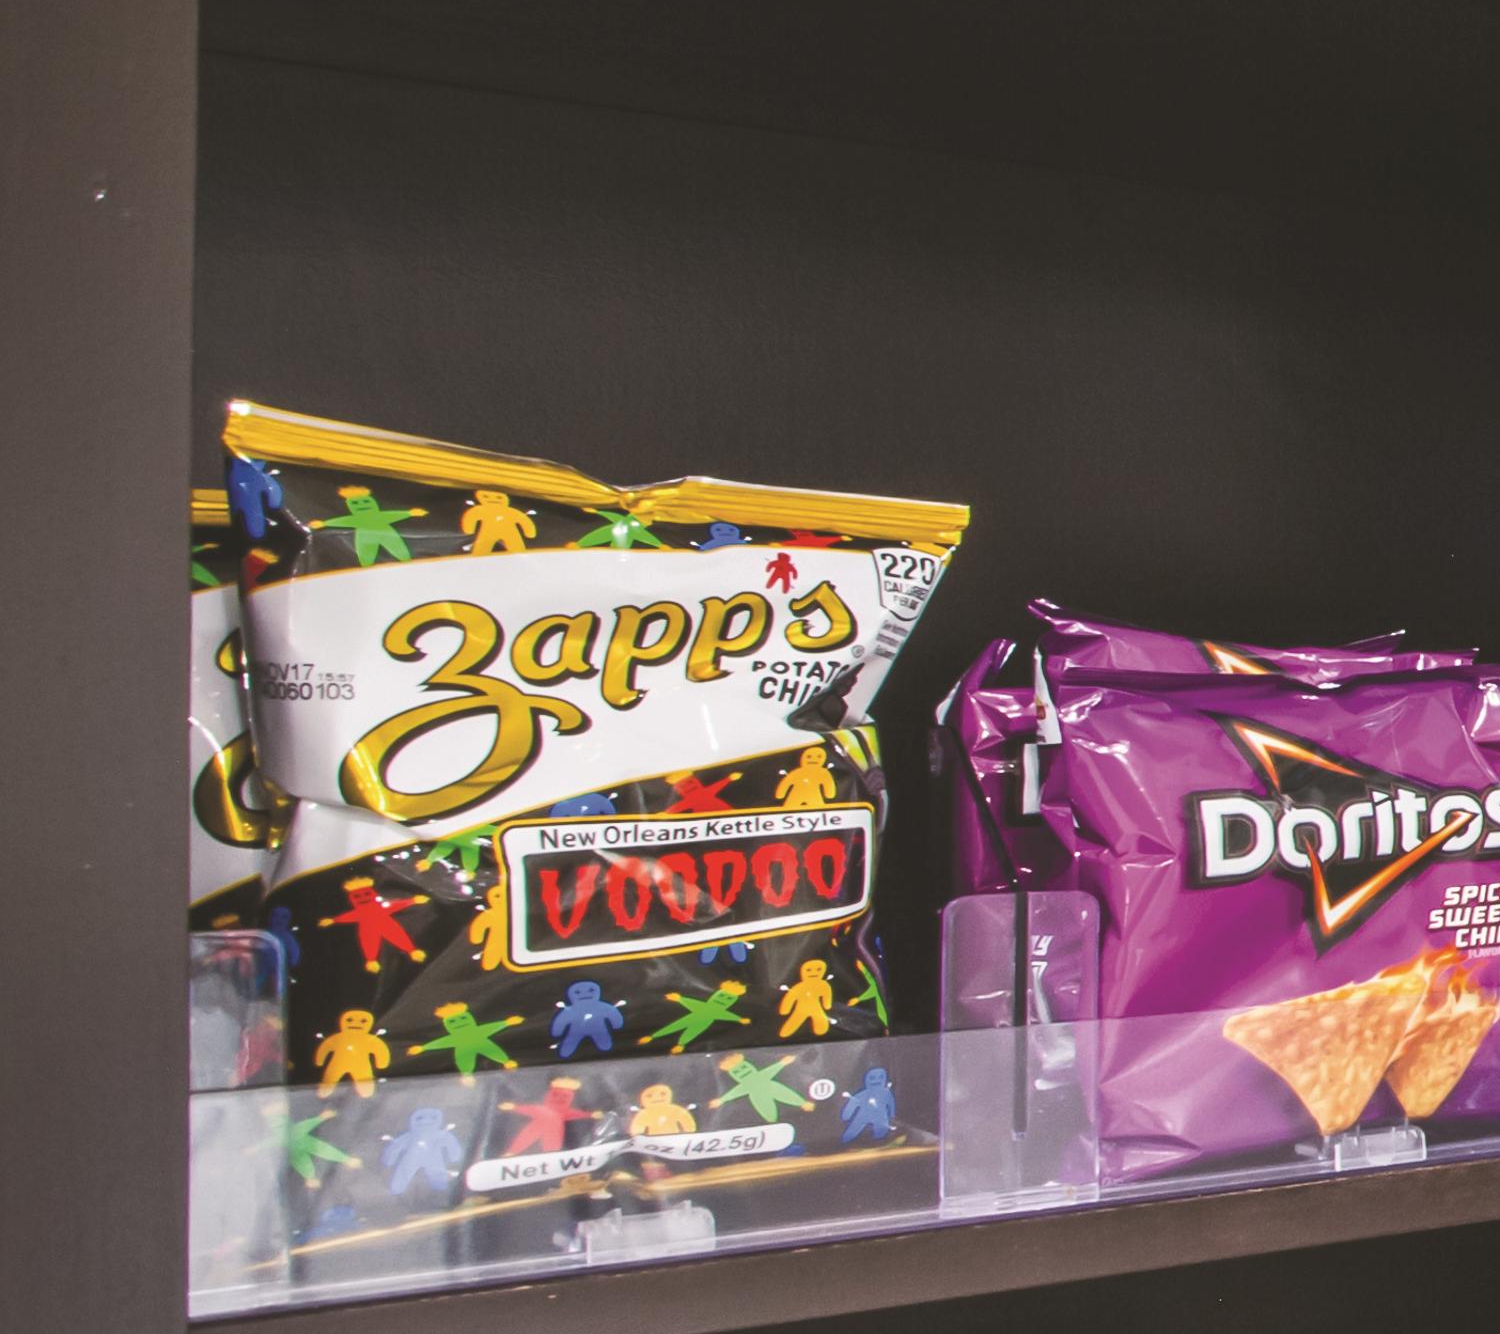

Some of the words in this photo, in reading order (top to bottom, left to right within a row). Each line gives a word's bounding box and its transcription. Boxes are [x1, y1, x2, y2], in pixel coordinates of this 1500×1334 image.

[539, 826, 596, 852] New
[602, 819, 699, 845] Orleans
[704, 816, 775, 839] Kettle
[780, 810, 843, 836] Style
[539, 838, 850, 940] VOODOO
[500, 1160, 547, 1182] Net
[560, 1153, 595, 1172] Wt
